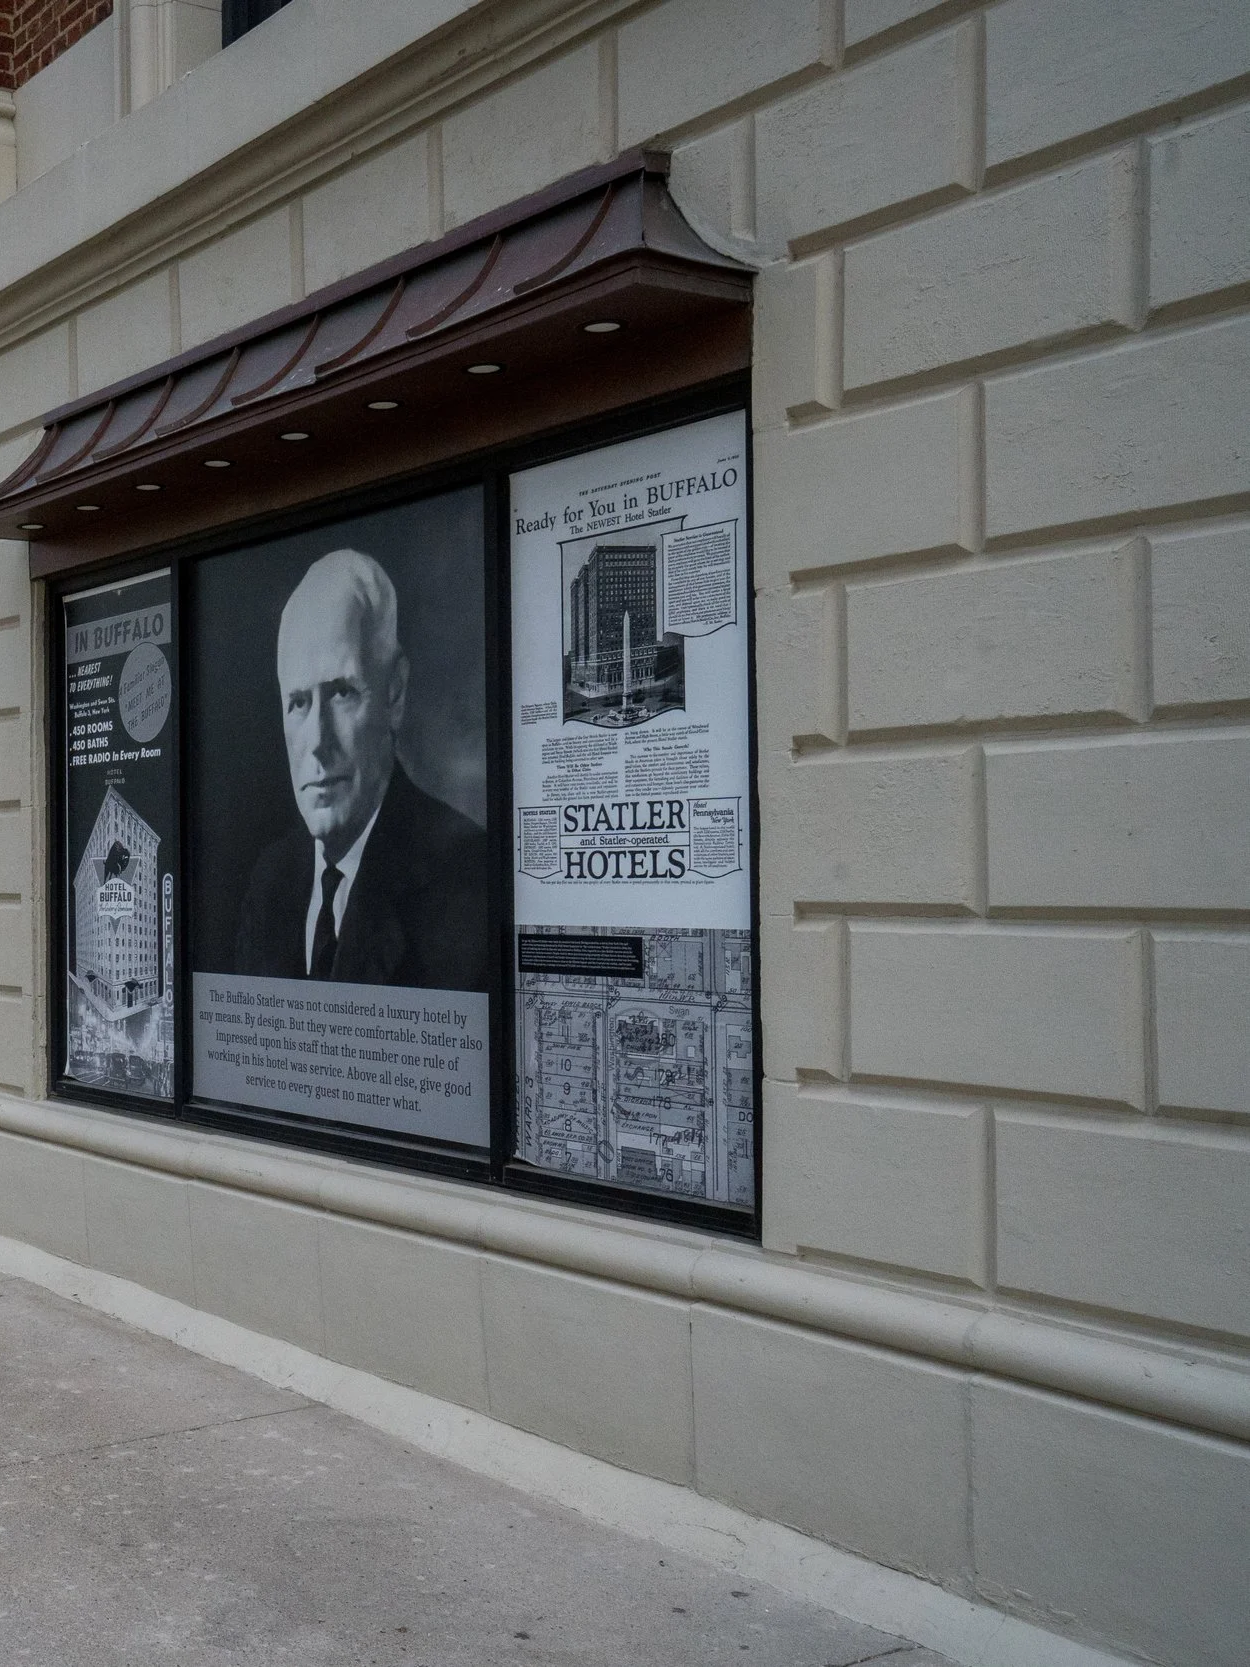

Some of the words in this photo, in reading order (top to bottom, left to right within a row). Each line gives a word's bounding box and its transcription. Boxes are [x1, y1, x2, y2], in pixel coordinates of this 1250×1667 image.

[591, 483, 617, 493] SATURDAY
[620, 476, 643, 487] EVENING
[646, 473, 661, 482] POST
[516, 512, 556, 535] Ready
[563, 506, 583, 524] for
[588, 500, 614, 518] You
[623, 494, 638, 510] in
[647, 468, 737, 505] BUFFALO
[570, 525, 583, 535] The
[587, 516, 621, 532] NEWEST
[625, 510, 644, 523] Hotel
[648, 505, 671, 518] Statler
[75, 629, 88, 654] IN
[93, 613, 164, 649] BUFFALO
[78, 662, 102, 677] NEAREST
[70, 681, 77, 693] TO
[77, 675, 113, 691] EVERYTHING!
[87, 720, 113, 734] ROOMS
[87, 736, 109, 749] BATHS
[73, 754, 87, 766] FREE
[88, 751, 110, 764] RADIO
[112, 751, 119, 762] In
[120, 749, 140, 761] Every
[141, 747, 161, 758] Room
[563, 800, 686, 833] STATLER
[693, 808, 735, 818] Pennsylvania
[580, 837, 596, 846] and
[564, 849, 686, 879] HOTELS
[100, 892, 132, 903] BUFFALO
[105, 883, 126, 891] HOTEL
[165, 880, 173, 1003] BUFFALO
[210, 989, 224, 1002] The
[226, 991, 255, 1006] Buffalo
[257, 994, 285, 1009] Statler
[287, 999, 304, 1011] was
[306, 1000, 321, 1012] not
[323, 1001, 376, 1017] considered
[379, 1007, 385, 1018] a
[387, 1005, 421, 1025] luxury
[423, 1008, 451, 1025] hotel
[454, 1010, 468, 1029] by
[669, 1006, 690, 1016] Swan
[200, 1010, 213, 1024] any
[215, 1012, 243, 1025] means.
[245, 1012, 256, 1029] By
[257, 1014, 287, 1032] design.
[289, 1017, 305, 1031] But
[307, 1019, 327, 1037] they
[329, 1024, 353, 1037] were
[355, 1025, 419, 1045] comfortable.
[421, 1030, 458, 1049] Statler
[460, 1035, 483, 1051] also
[216, 1029, 258, 1047] impressed
[259, 1037, 281, 1051] upon
[283, 1037, 297, 1051] his
[299, 1040, 319, 1055] staff
[321, 1042, 339, 1058] that
[341, 1044, 357, 1059] the
[359, 1047, 400, 1064] number
[401, 1054, 421, 1067] one
[423, 1054, 445, 1070] rule
[447, 1057, 460, 1072] of
[207, 1049, 240, 1067] working
[242, 1052, 250, 1065] in
[252, 1053, 265, 1067] his
[266, 1055, 288, 1071] hotel
[290, 1061, 308, 1073] was
[310, 1064, 345, 1079] service.
[347, 1066, 377, 1083] Above
[379, 1071, 392, 1086] all
[394, 1073, 418, 1091] else,
[420, 1077, 442, 1094] give
[444, 1081, 472, 1098] good
[561, 1059, 572, 1072] 10
[245, 1074, 276, 1090] service
[277, 1081, 287, 1091] to
[288, 1081, 313, 1098] every
[315, 1085, 340, 1100] guest
[342, 1090, 355, 1102] no
[357, 1092, 390, 1107] matter
[392, 1095, 422, 1112] what.
[524, 1096, 533, 1147] WARD
